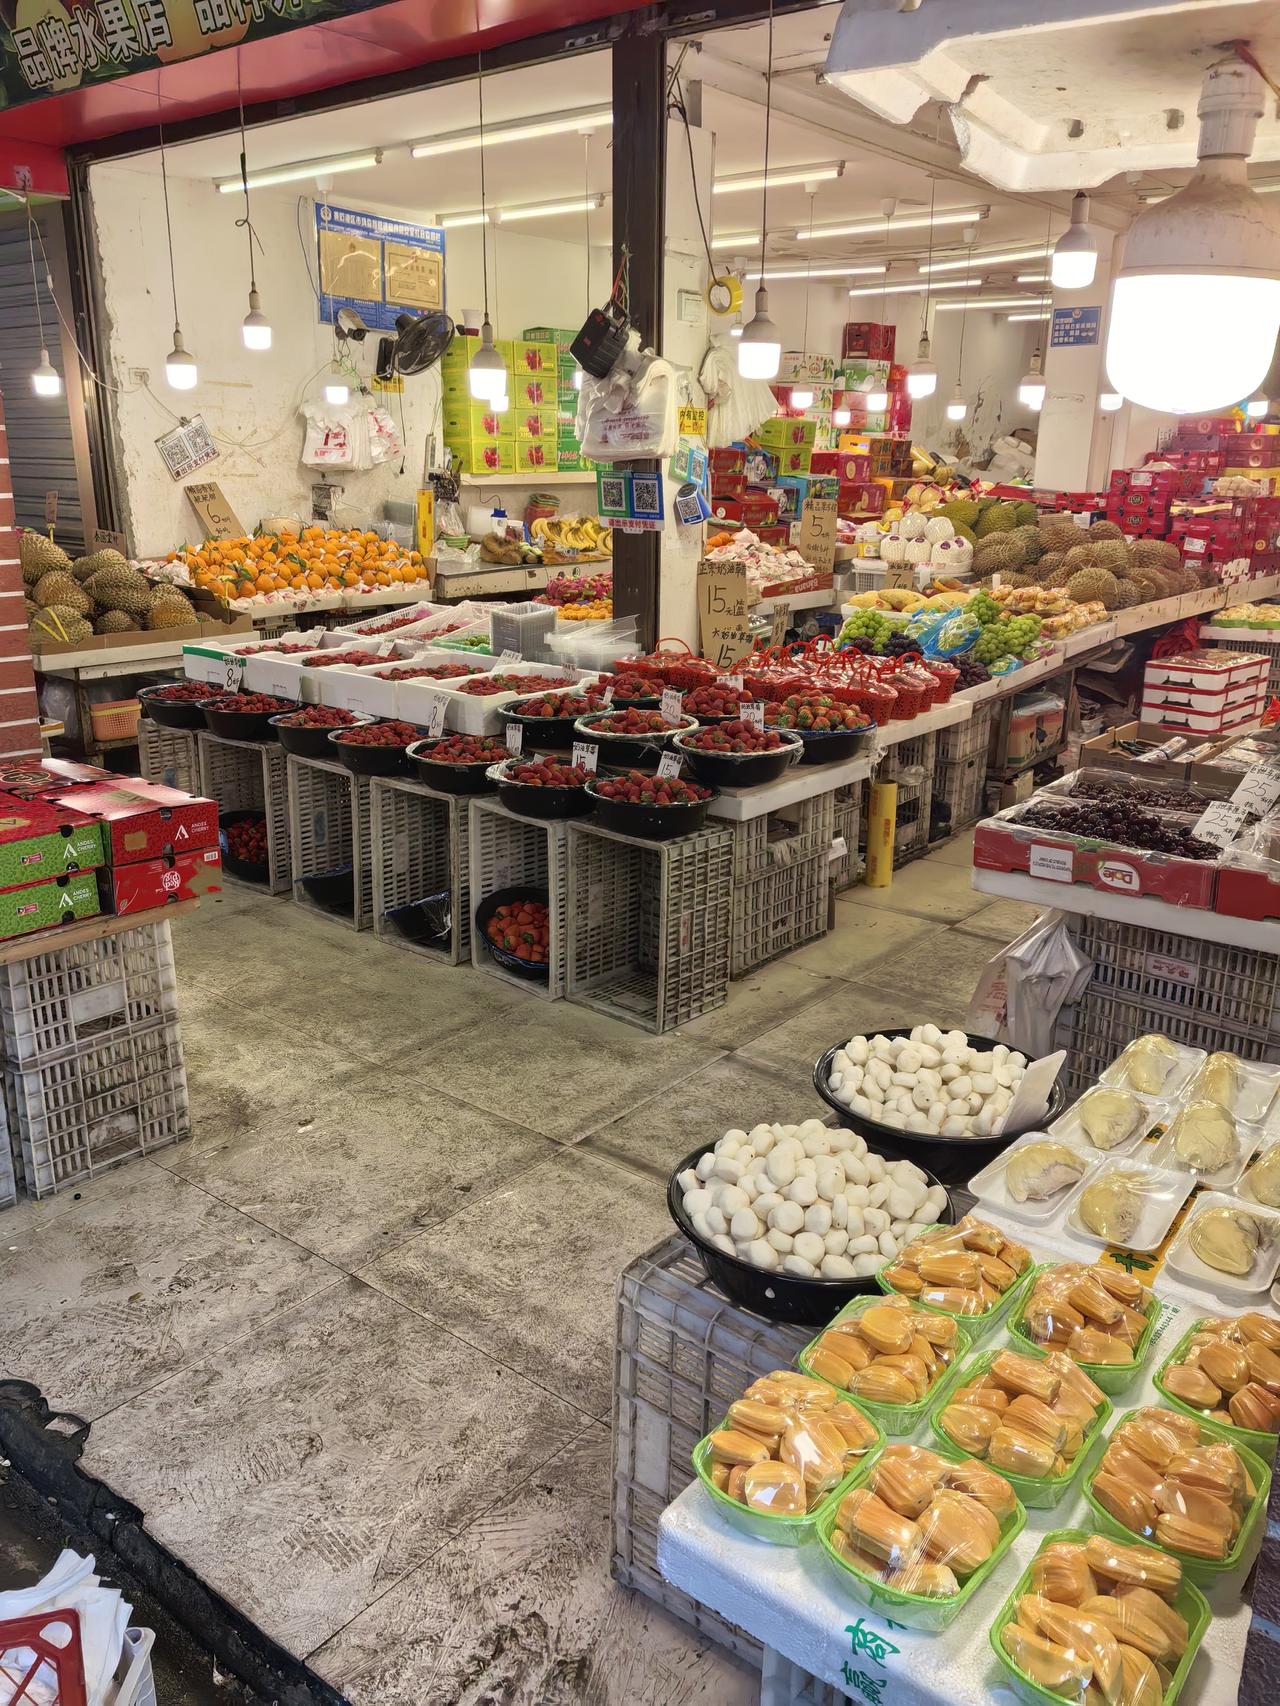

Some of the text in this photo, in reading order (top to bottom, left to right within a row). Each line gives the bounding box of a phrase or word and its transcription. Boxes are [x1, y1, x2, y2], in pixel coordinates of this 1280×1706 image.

[11, 0, 172, 88] 品牌水果店
[608, 518, 656, 529] 请出示支付凭证
[191, 826, 209, 834] CHERRY
[77, 840, 94, 848] ANDES
[77, 844, 96, 854] CHERRY
[1102, 869, 1133, 885] Dole
[73, 888, 89, 896] ANDES
[73, 893, 93, 902] CHERRY
